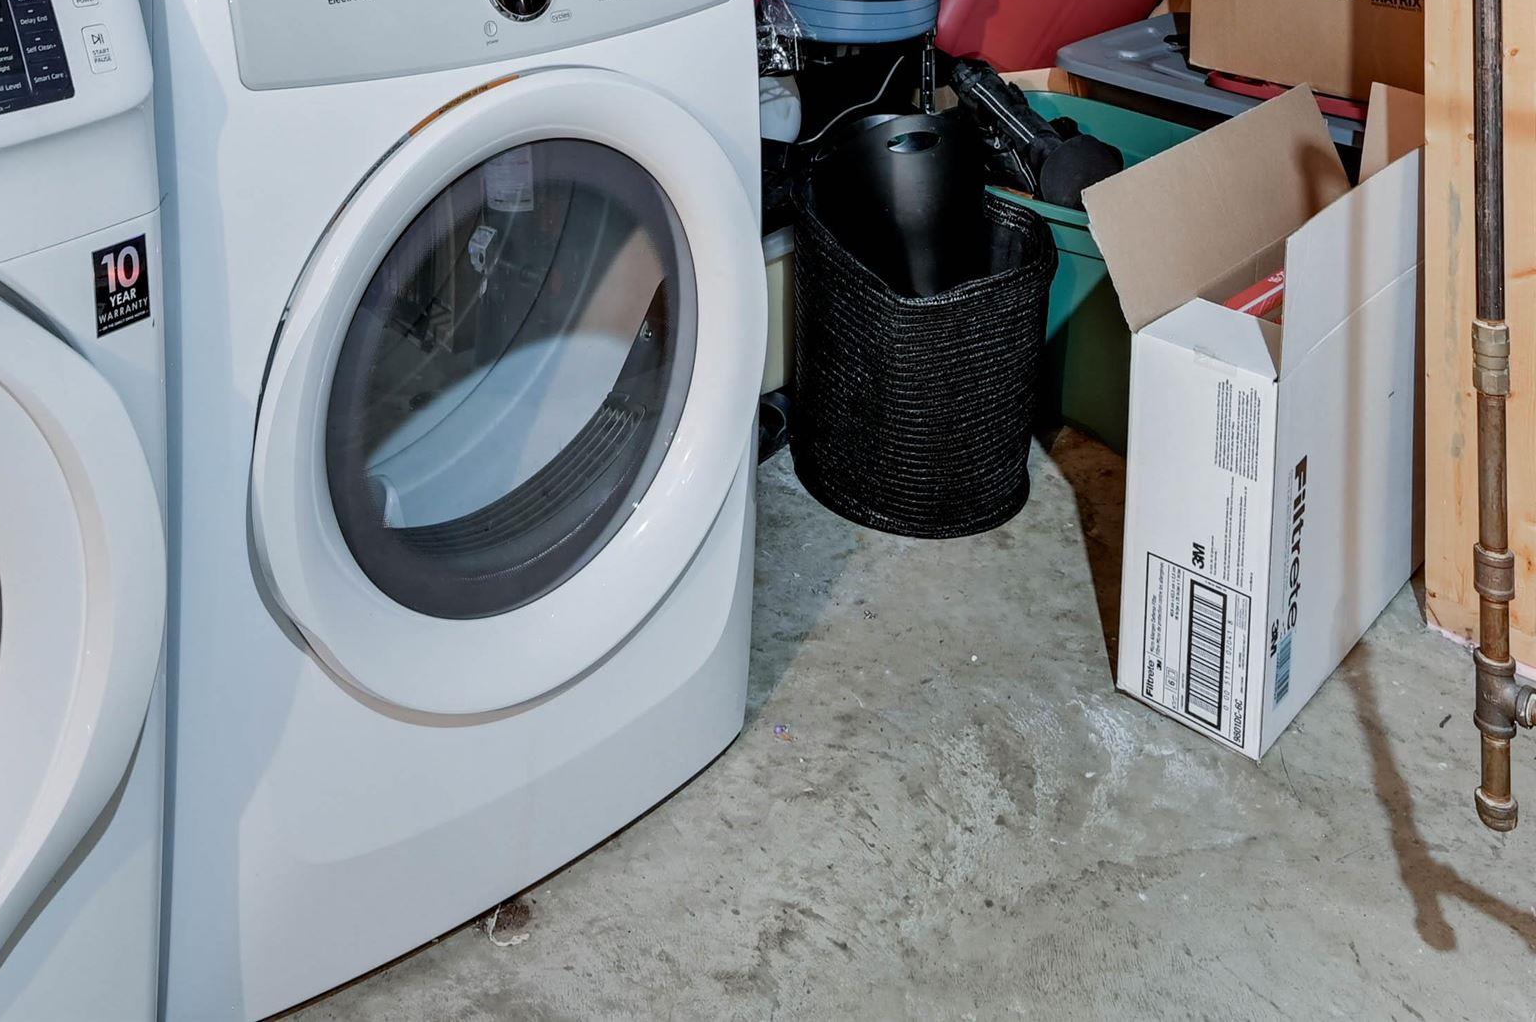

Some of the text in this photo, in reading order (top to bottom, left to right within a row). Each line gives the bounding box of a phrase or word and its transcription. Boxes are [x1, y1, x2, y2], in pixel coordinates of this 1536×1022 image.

[20, 15, 48, 27] Delay End
[5, 81, 23, 91] Level
[33, 74, 51, 84] Smart
[100, 245, 141, 294] 10
[98, 296, 150, 325] WARRANTY
[109, 287, 137, 308] YEAR
[1191, 542, 1206, 570] 3M
[1286, 454, 1309, 631] Filtrete
[1145, 659, 1156, 698] Filtrete
